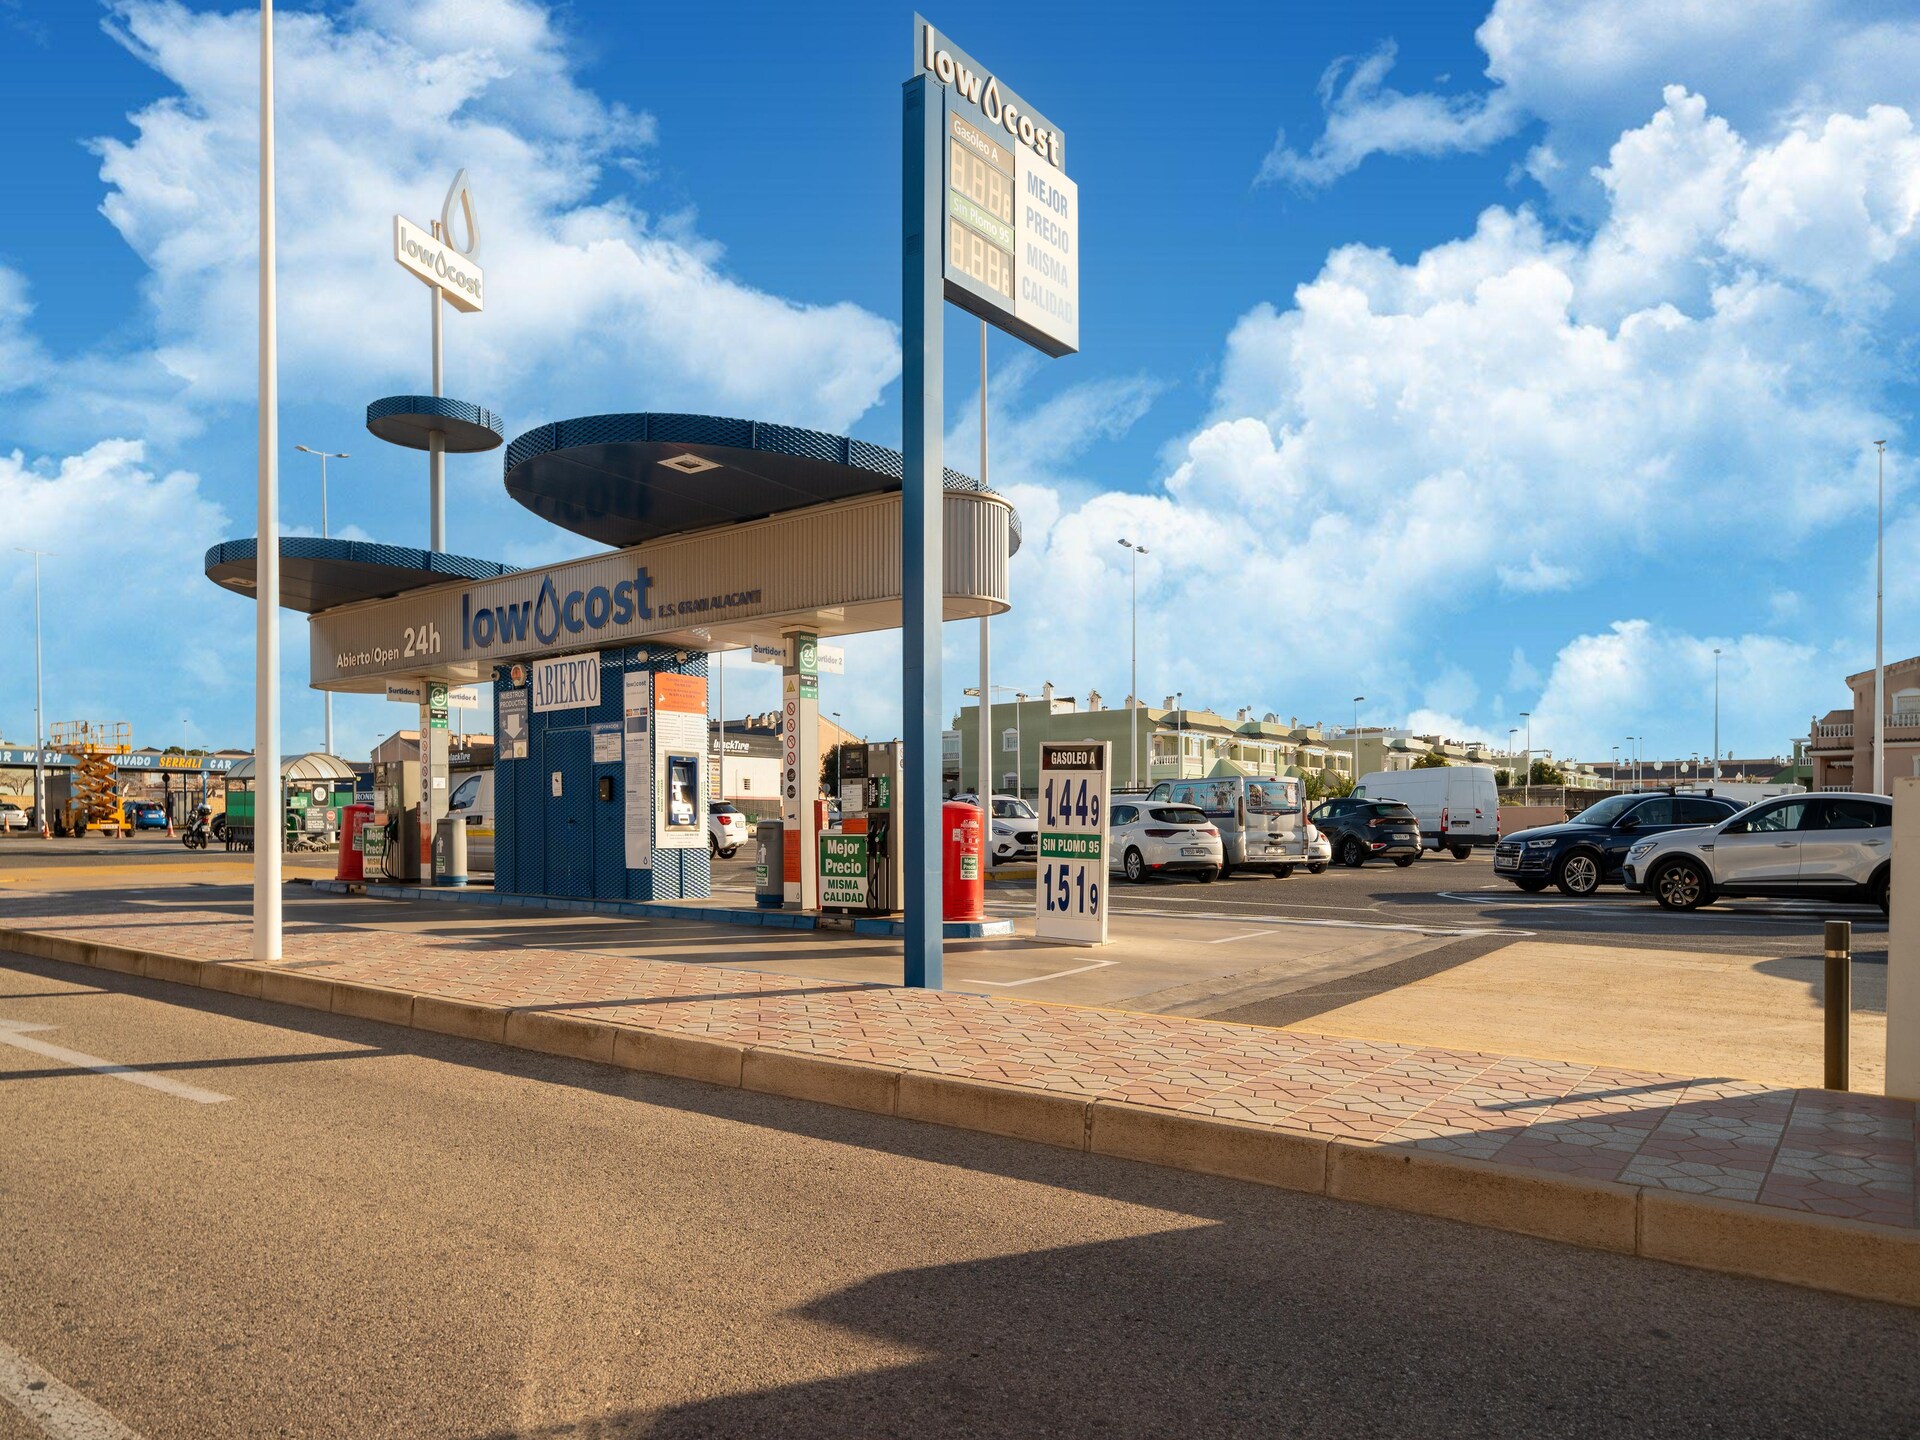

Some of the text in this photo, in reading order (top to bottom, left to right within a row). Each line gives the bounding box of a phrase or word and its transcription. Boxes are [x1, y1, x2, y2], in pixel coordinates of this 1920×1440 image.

[954, 121, 999, 163] Gasóleo A
[1027, 170, 1068, 219] MEJOR
[953, 197, 1010, 244] Sin Plomo 95
[1027, 205, 1069, 255] PRECIO
[1027, 242, 1068, 292] MISMA
[1022, 275, 1073, 324] CALIDAD
[678, 598, 709, 615] GRAN
[404, 622, 441, 658] 24h
[753, 644, 786, 657] Surtidor 1
[804, 648, 814, 658] 24
[817, 655, 843, 665] urtidor 2
[536, 658, 598, 707] ABIERTO
[388, 686, 414, 696] Surtidor
[501, 690, 525, 700] NUESTROS
[500, 699, 527, 709] PRODUCTOS
[23, 751, 62, 764] WSH
[210, 758, 232, 770] CAR
[1051, 751, 1096, 765] GASOLEO A
[827, 838, 860, 857] Mejor
[1042, 838, 1100, 853] SIN PLOMO 95
[825, 858, 862, 874] Precio
[827, 879, 859, 890] MISMA
[823, 891, 864, 903] CALIDAD
